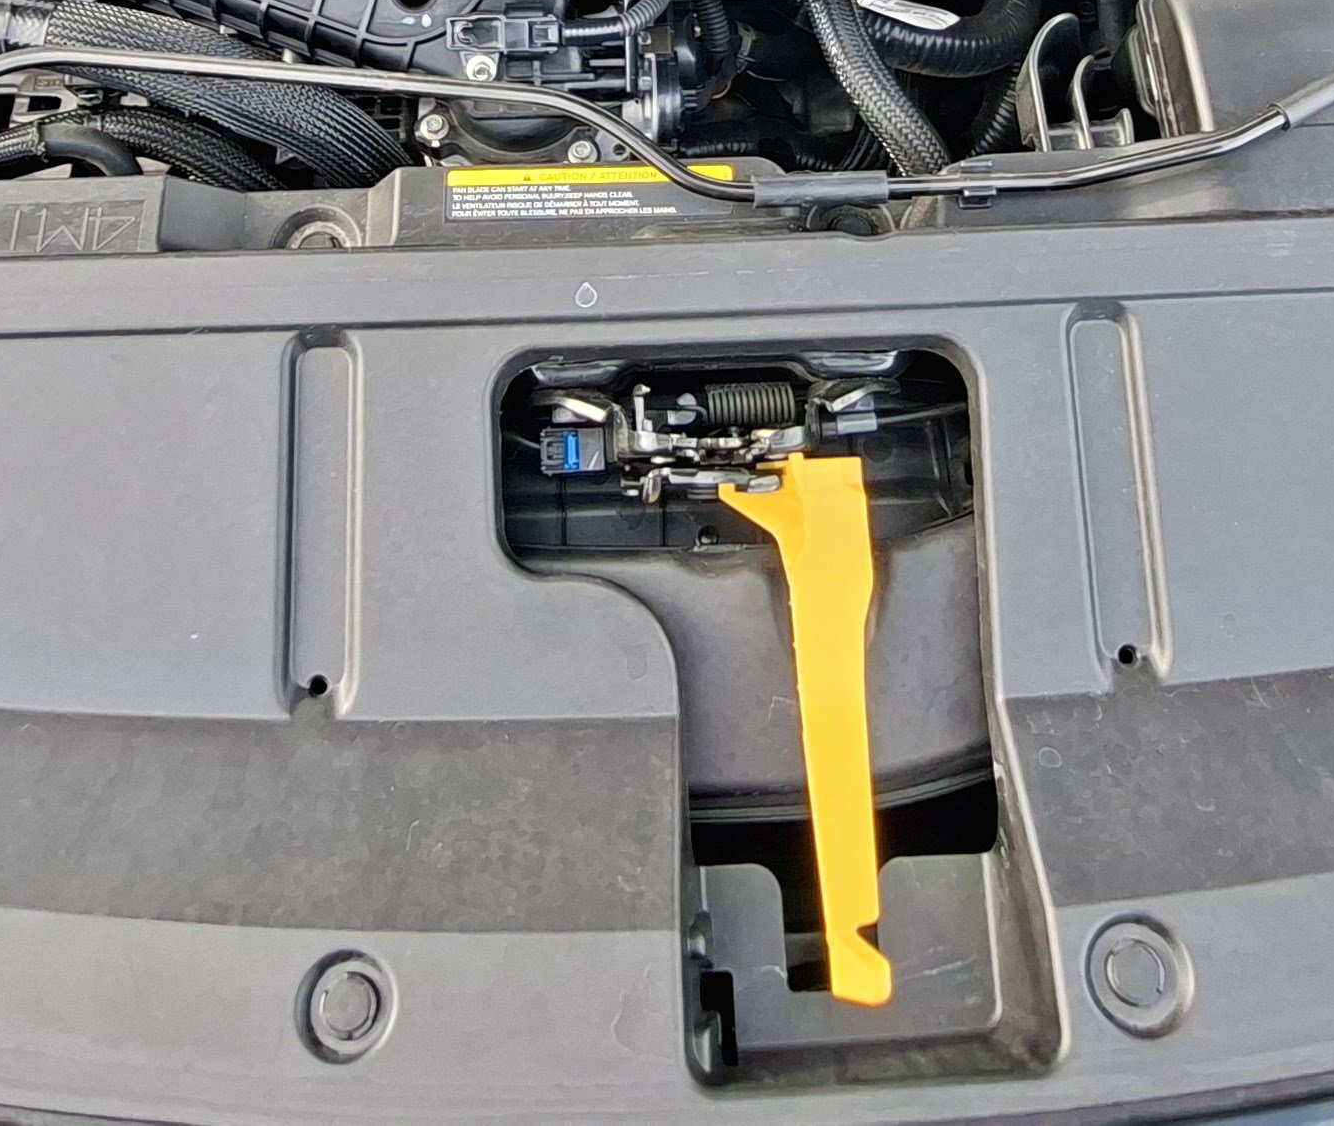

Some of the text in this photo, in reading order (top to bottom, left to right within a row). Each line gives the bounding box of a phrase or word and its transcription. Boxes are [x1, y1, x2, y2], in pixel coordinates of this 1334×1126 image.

[539, 173, 587, 181] CAUTION
[599, 171, 657, 180] ATTENTION
[544, 200, 582, 208] DÉMARRER
[473, 209, 496, 217] ÉVITER
[596, 207, 638, 215] APPROCHER
